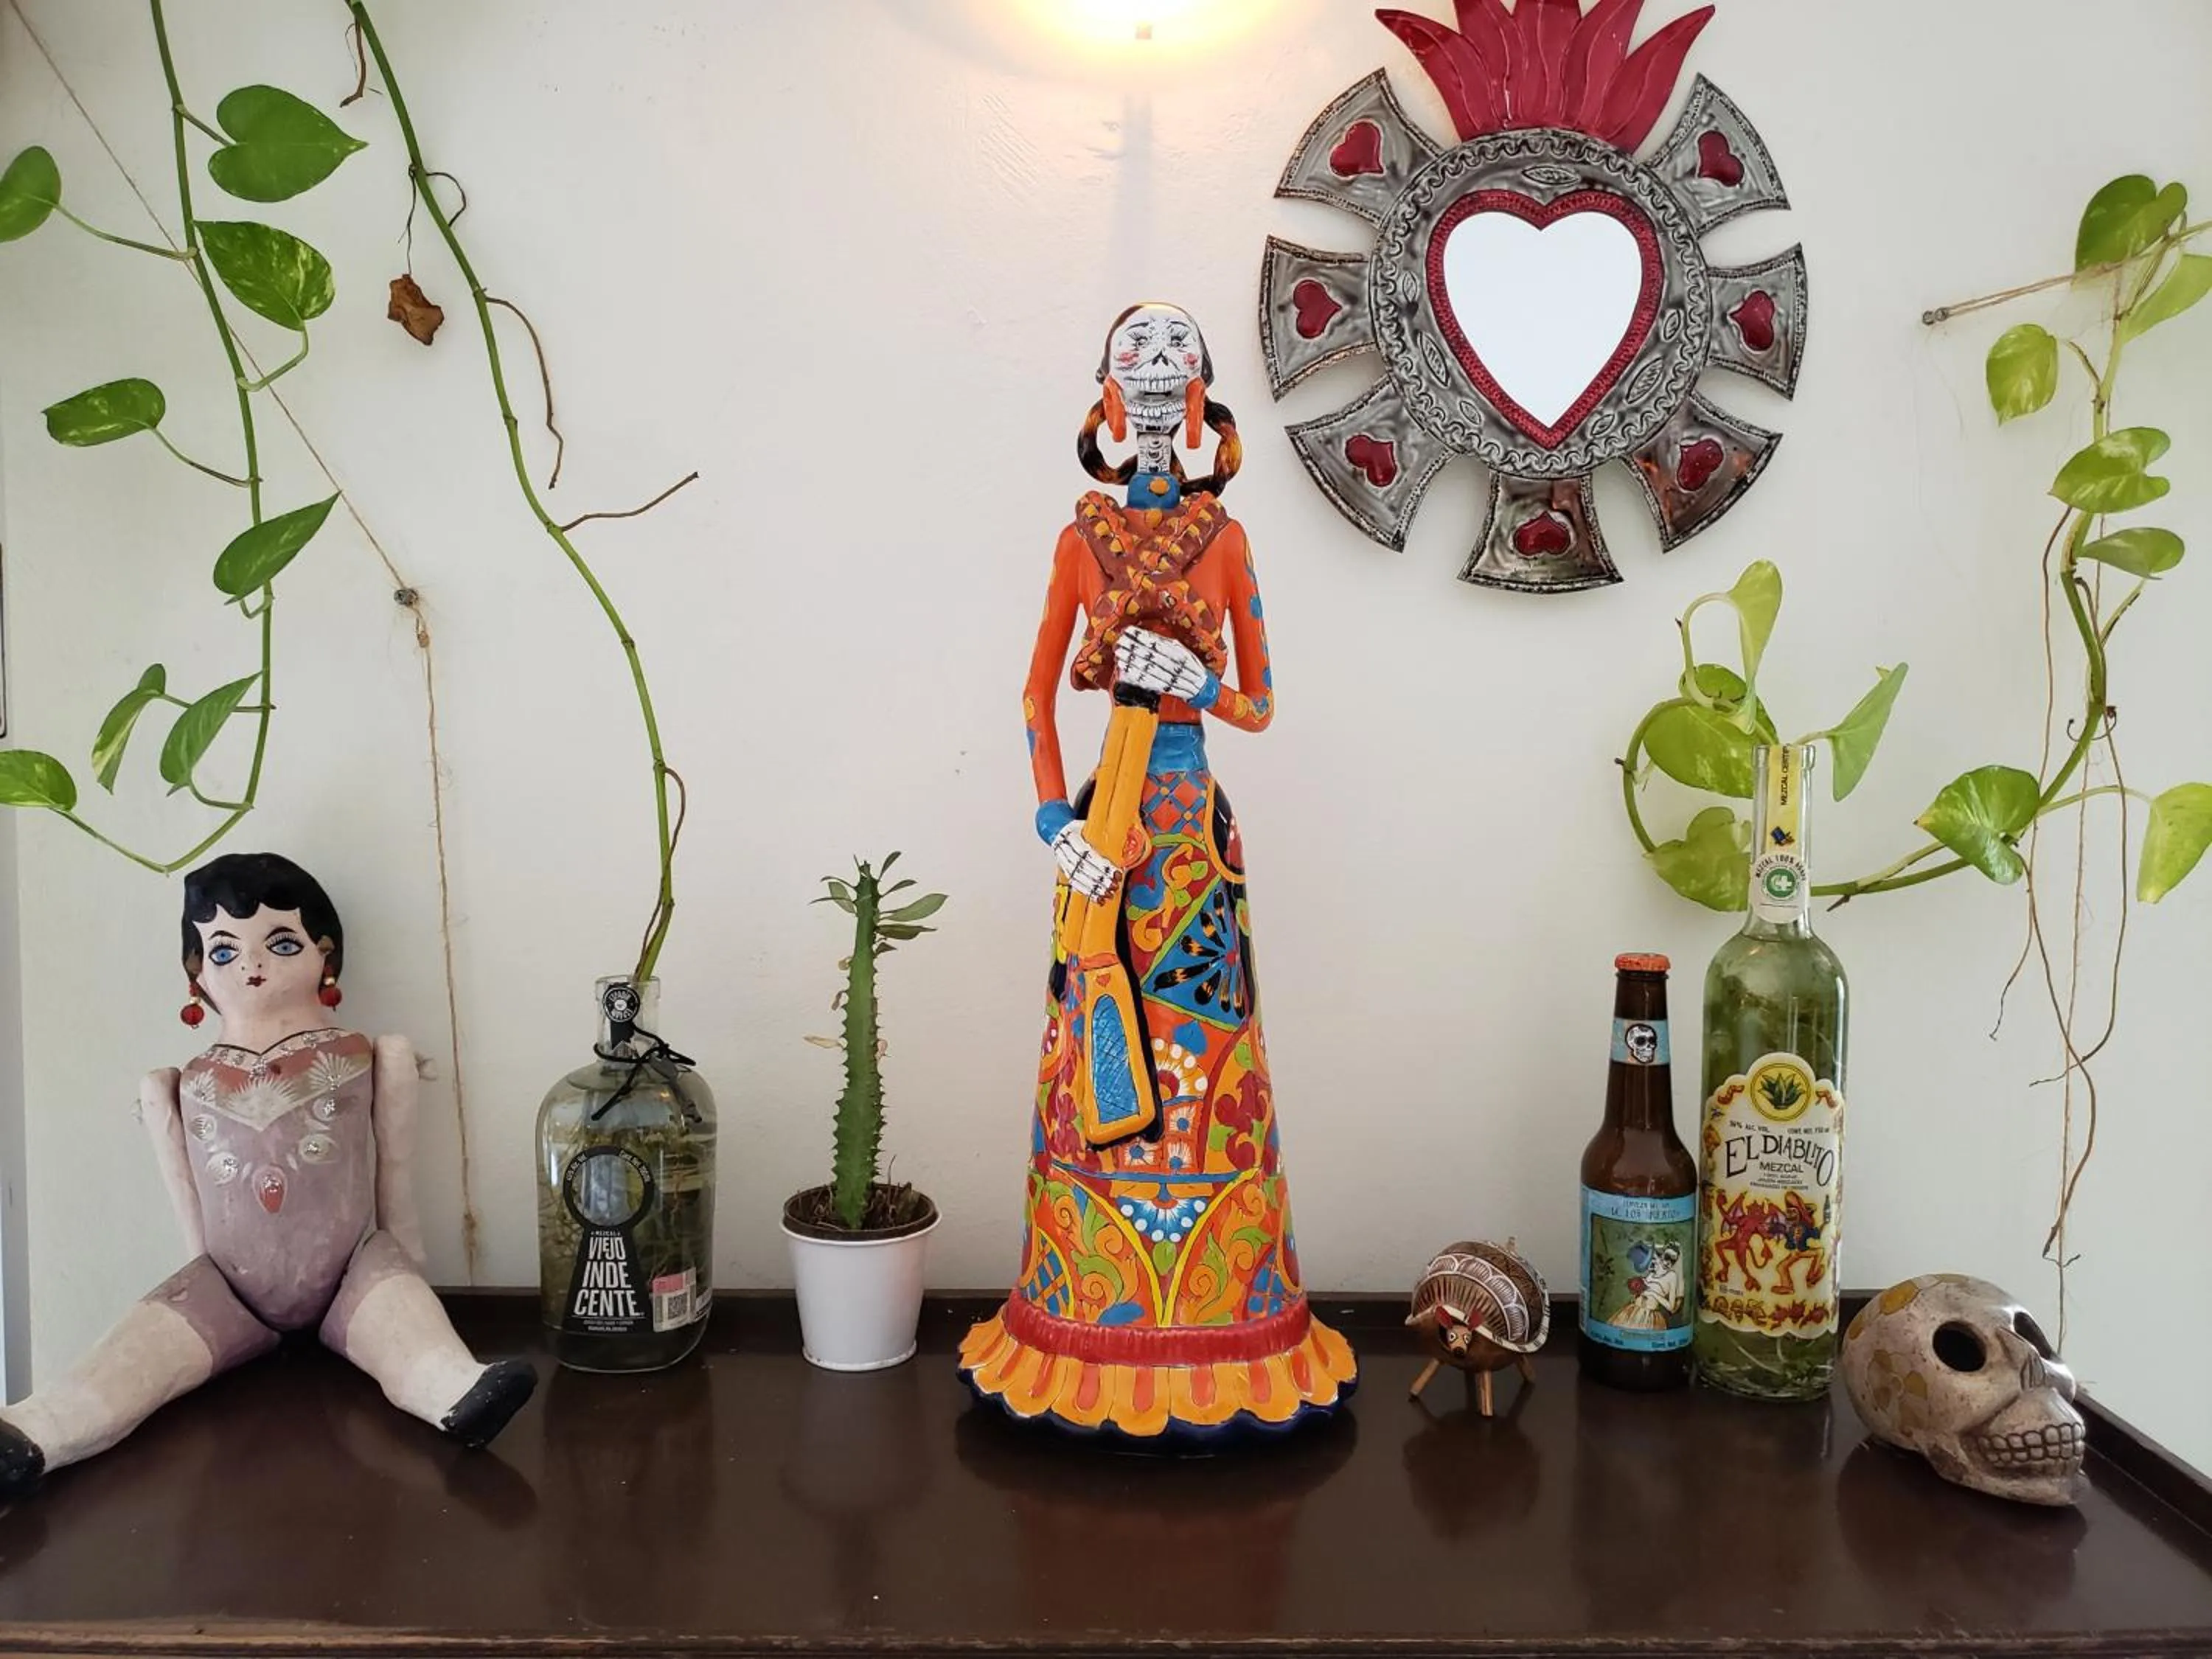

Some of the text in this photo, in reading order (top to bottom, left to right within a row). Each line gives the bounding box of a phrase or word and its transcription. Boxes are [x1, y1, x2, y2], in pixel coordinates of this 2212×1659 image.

[1725, 1135, 1834, 1186] EL DIABLITO
[1759, 1161, 1804, 1173] MEZCAL
[588, 1237, 626, 1260] VIEJO
[582, 1261, 632, 1288] INDE
[574, 1289, 641, 1316] CENTE
